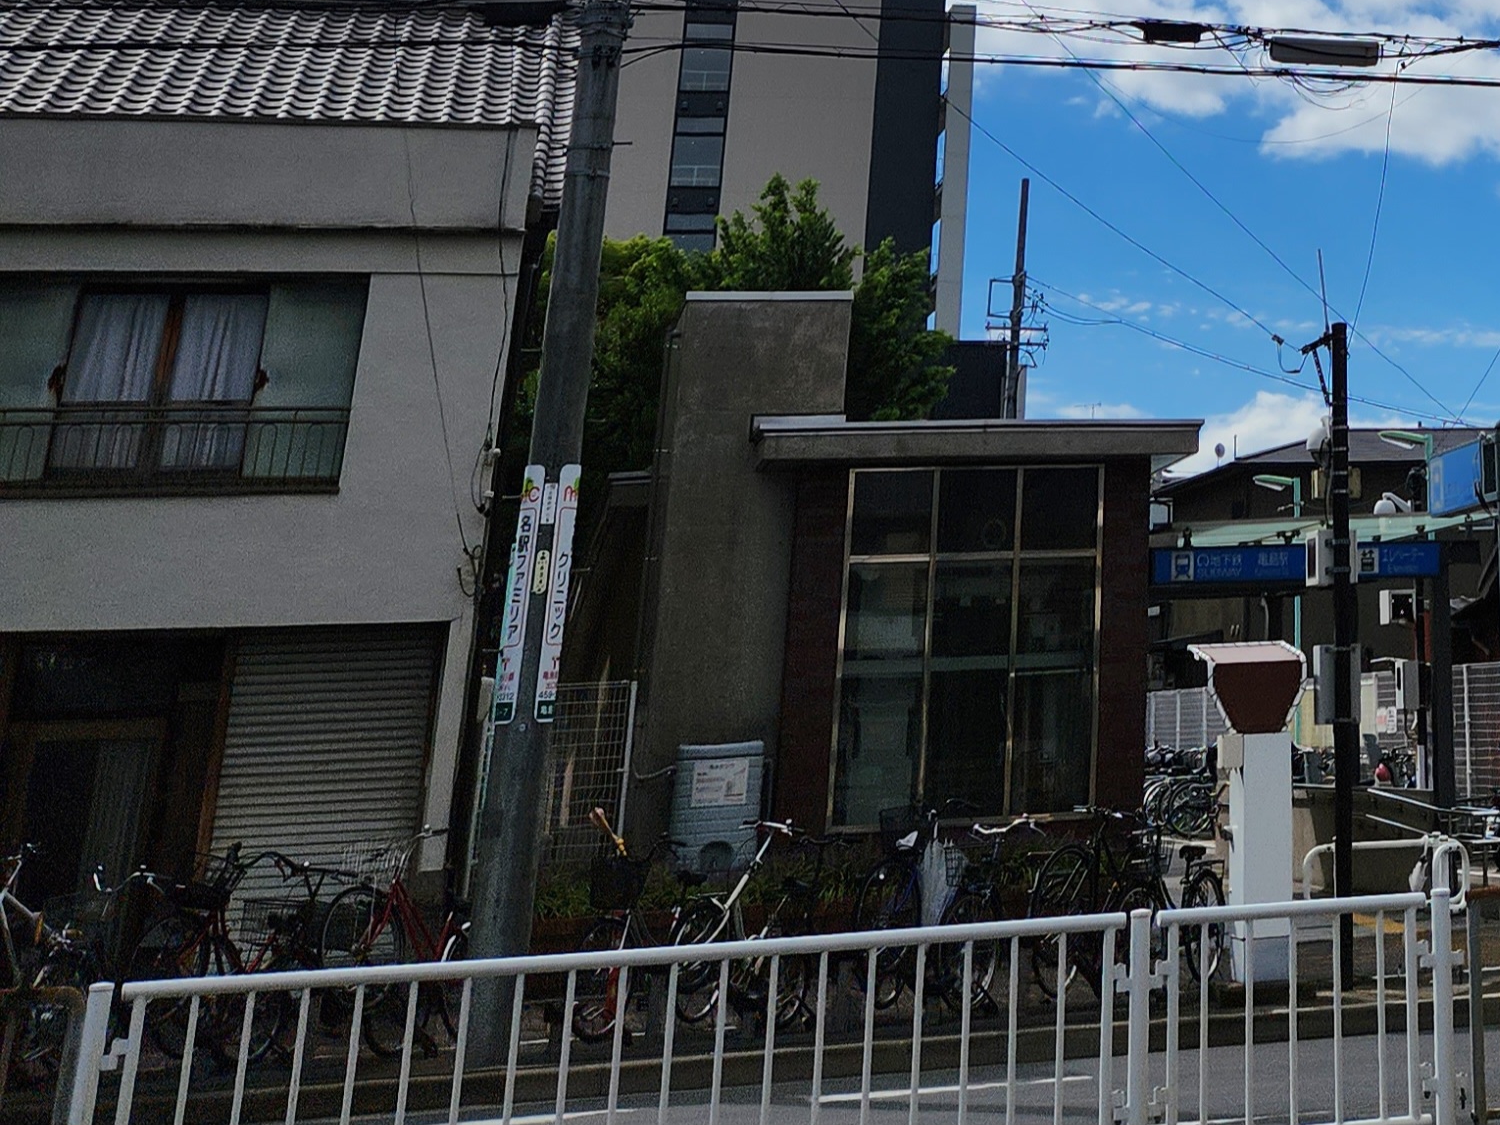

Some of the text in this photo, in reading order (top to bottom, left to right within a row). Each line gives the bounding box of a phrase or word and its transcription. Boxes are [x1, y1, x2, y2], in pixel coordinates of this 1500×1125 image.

[506, 516, 531, 641] 名駅ファミリア
[551, 552, 569, 640] クリニック
